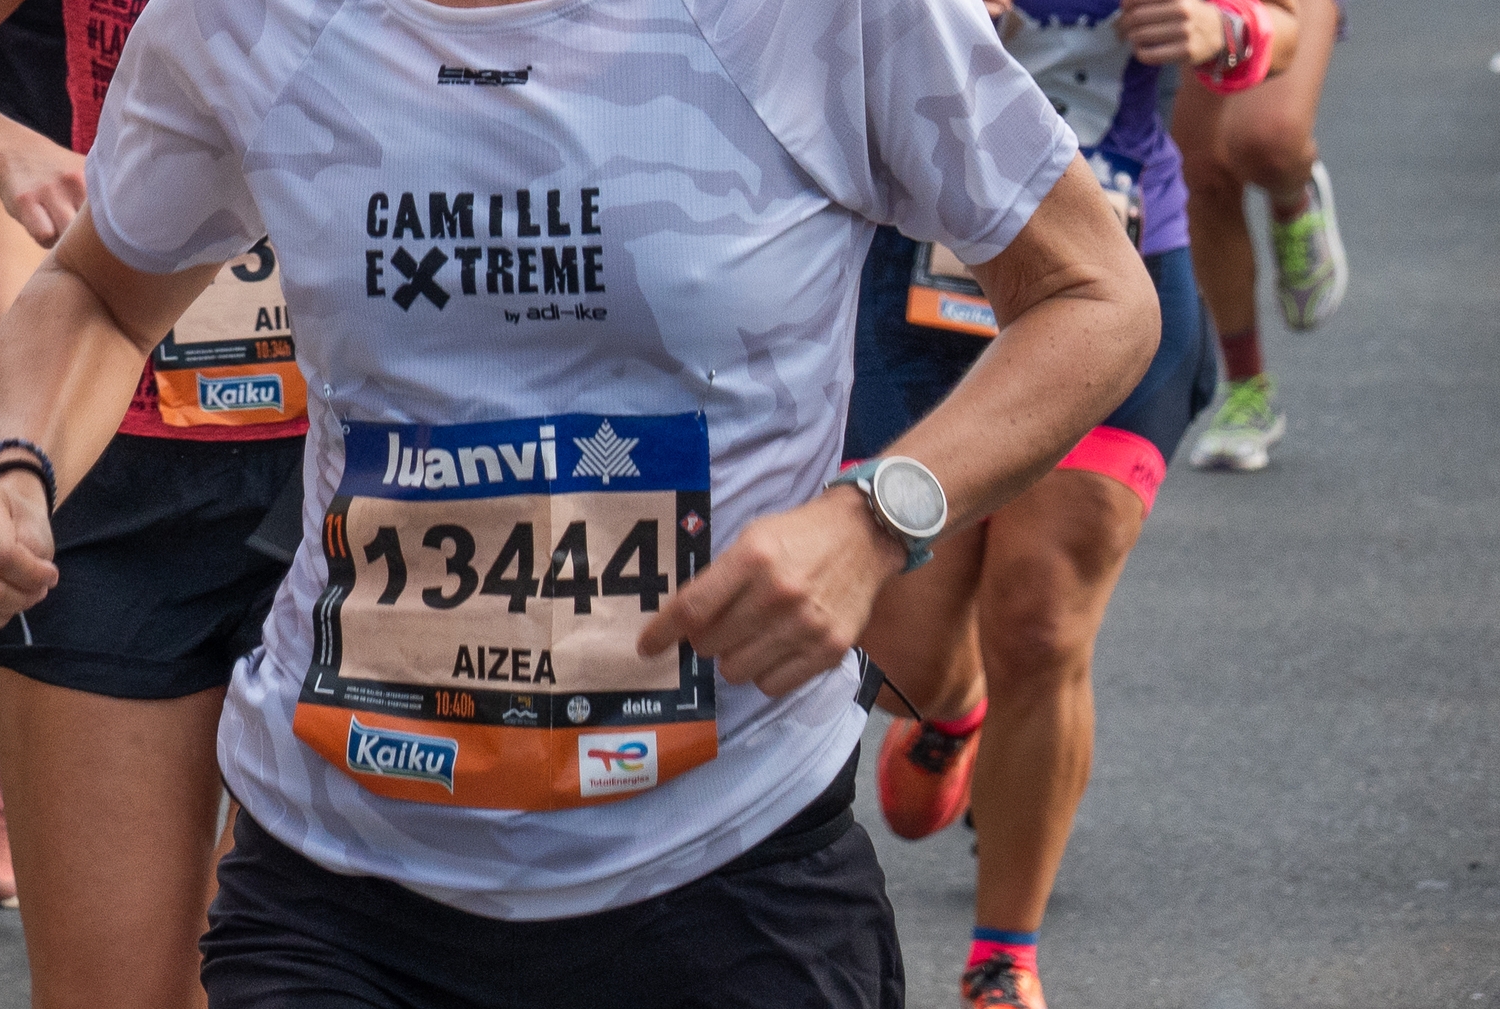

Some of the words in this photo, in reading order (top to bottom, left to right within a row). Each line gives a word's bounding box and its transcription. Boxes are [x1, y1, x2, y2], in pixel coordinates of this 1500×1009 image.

[366, 187, 601, 240] CAMILLE
[365, 246, 606, 312] EXTREME
[504, 308, 520, 325] by
[206, 381, 276, 410] Kaiku
[382, 424, 558, 490] luanvi
[325, 513, 347, 559] 11
[362, 518, 669, 615] 13444
[451, 645, 557, 685] AIZEA
[435, 691, 476, 718] 10:40h
[622, 698, 663, 715] delta
[355, 733, 447, 776] Kaiku
